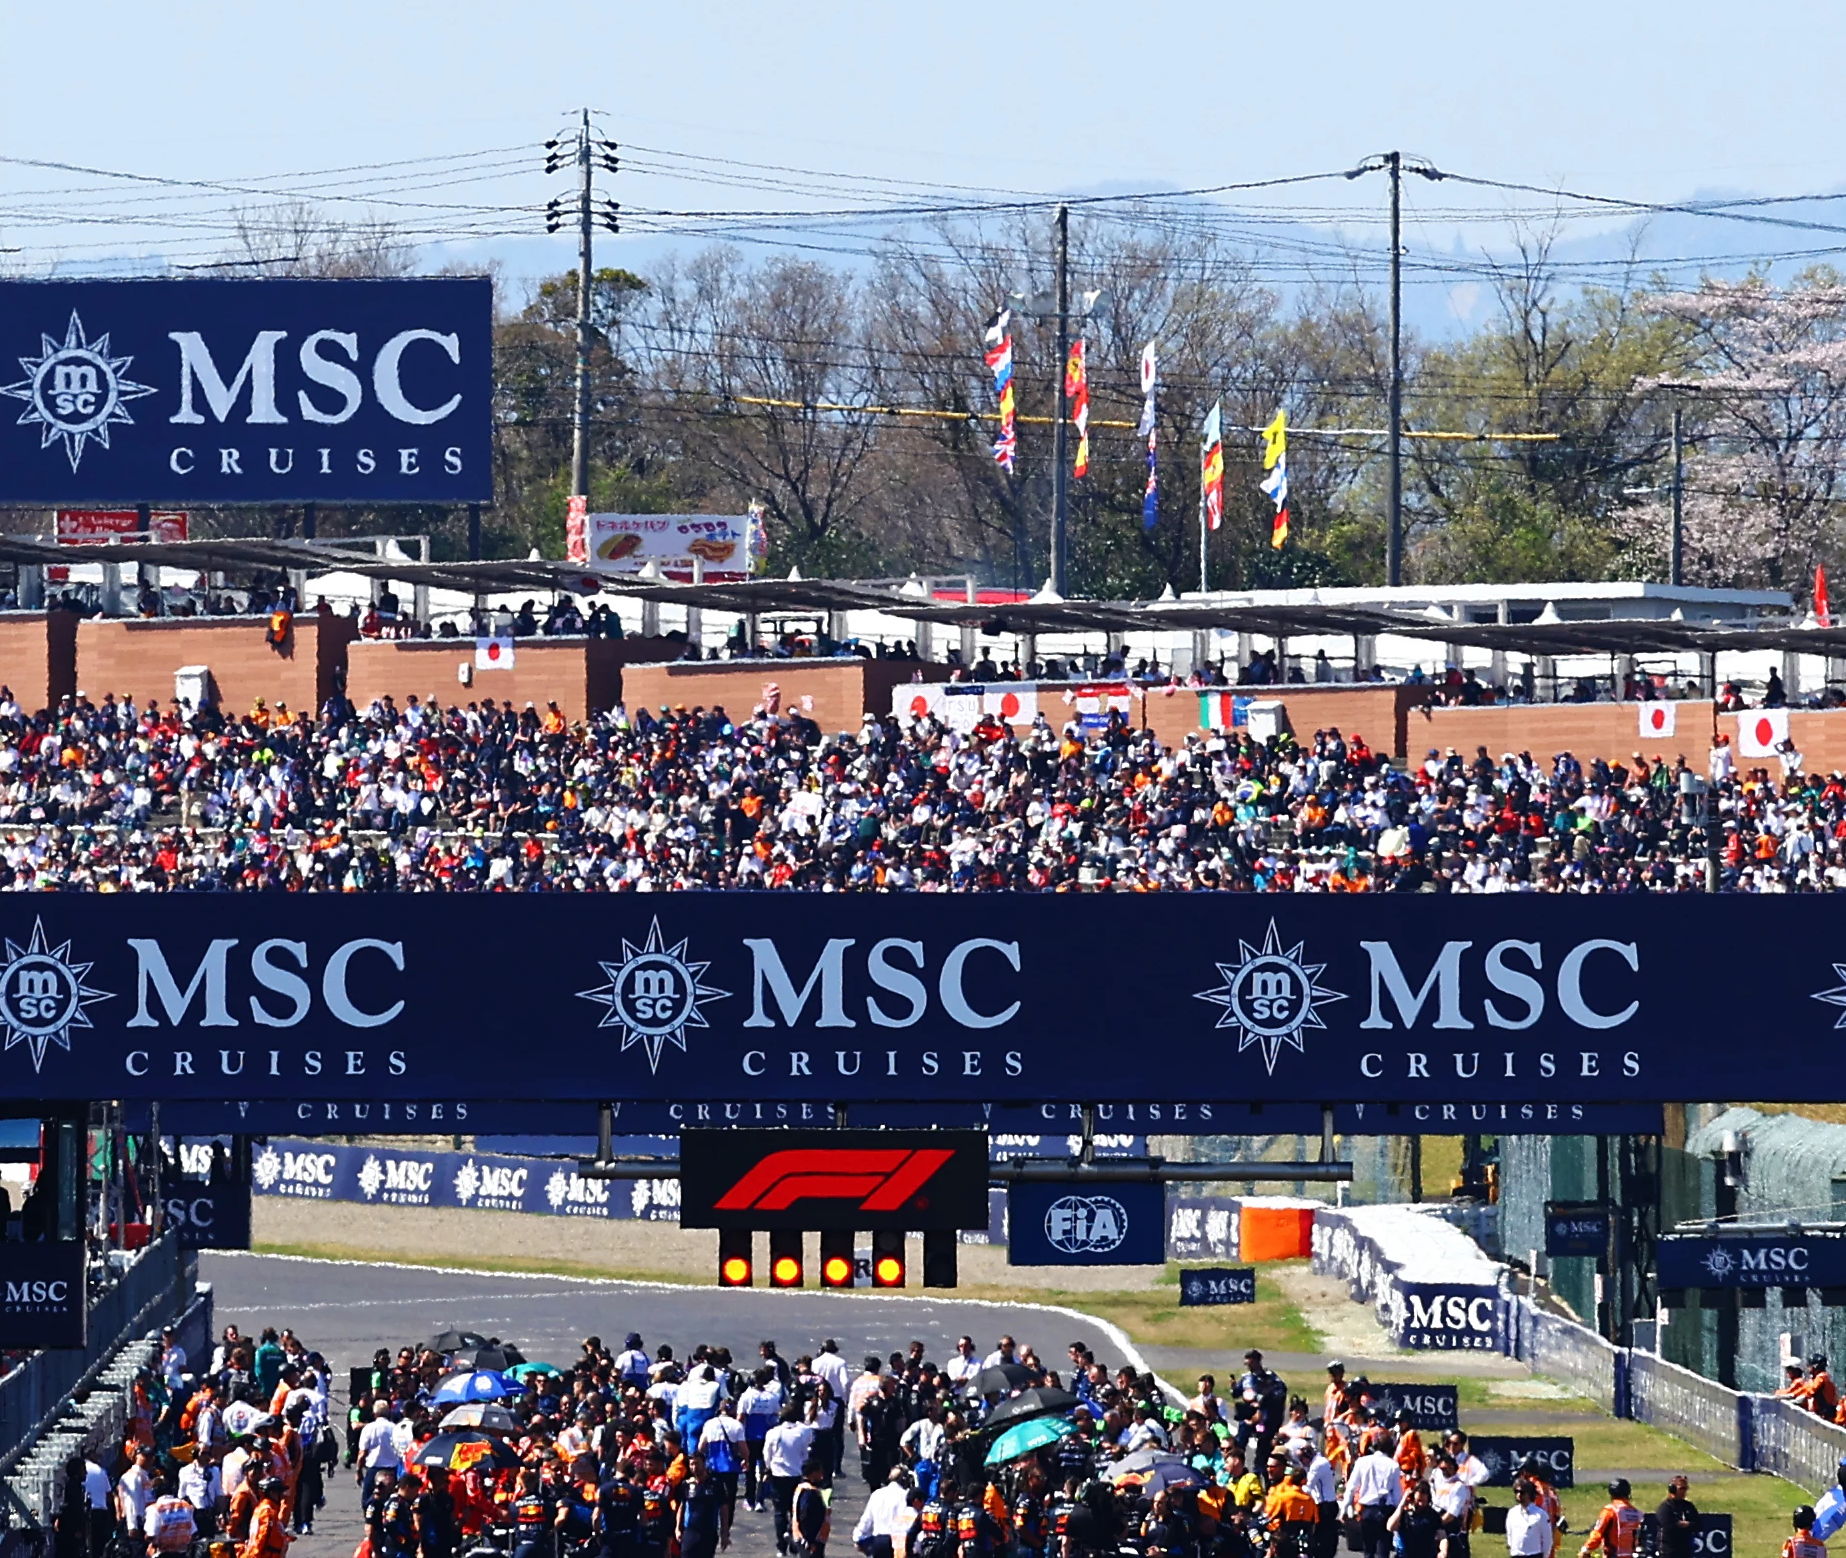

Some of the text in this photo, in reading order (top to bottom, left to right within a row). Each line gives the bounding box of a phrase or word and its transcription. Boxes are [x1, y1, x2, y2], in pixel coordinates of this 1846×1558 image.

[168, 328, 463, 425] MSC
[170, 447, 463, 475] CRUISES
[126, 938, 406, 1029] MSC
[742, 938, 1022, 1029] MSC
[1359, 939, 1640, 1030] MSC
[125, 1050, 407, 1076] CRUISES
[741, 1050, 1023, 1076] CRUISES
[1359, 1051, 1642, 1078] CRUISES
[297, 1102, 469, 1120] CRUISES
[669, 1102, 838, 1120] CRUISES
[1041, 1102, 1215, 1121] CRUISES
[1414, 1103, 1585, 1121] CRUISES
[282, 1151, 336, 1185] MSC
[384, 1159, 434, 1193] MSC
[481, 1165, 529, 1199] MSC
[1740, 1247, 1810, 1272] MSC
[6, 1280, 69, 1303] MSC
[1208, 1278, 1252, 1296] MSC
[1409, 1294, 1494, 1333] MSC
[1402, 1394, 1454, 1417] MSC
[1694, 1529, 1728, 1553] SC
